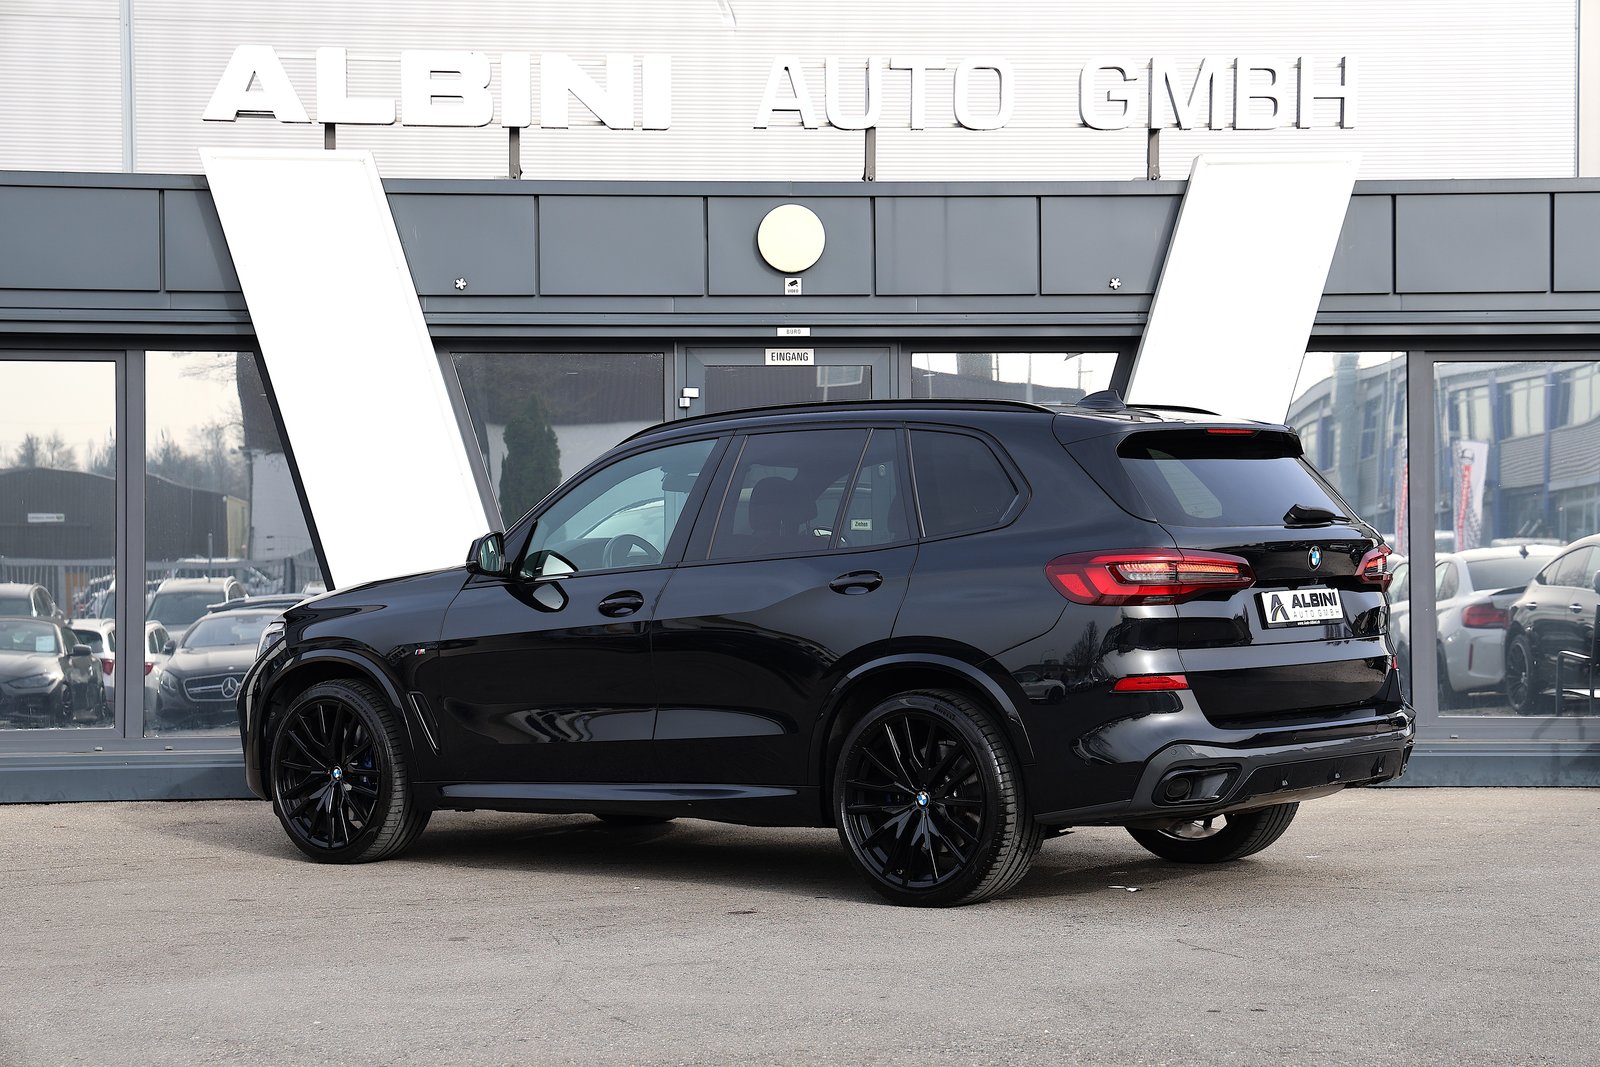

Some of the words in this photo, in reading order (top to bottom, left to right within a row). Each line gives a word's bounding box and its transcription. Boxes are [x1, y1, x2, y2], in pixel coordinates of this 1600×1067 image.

[202, 44, 672, 131] ALBINI
[753, 56, 1015, 131] AUTO
[1078, 56, 1357, 131] GMBH
[771, 352, 809, 361] EINGANG
[1292, 592, 1338, 608] ALBINI
[1293, 609, 1315, 619] AUTO
